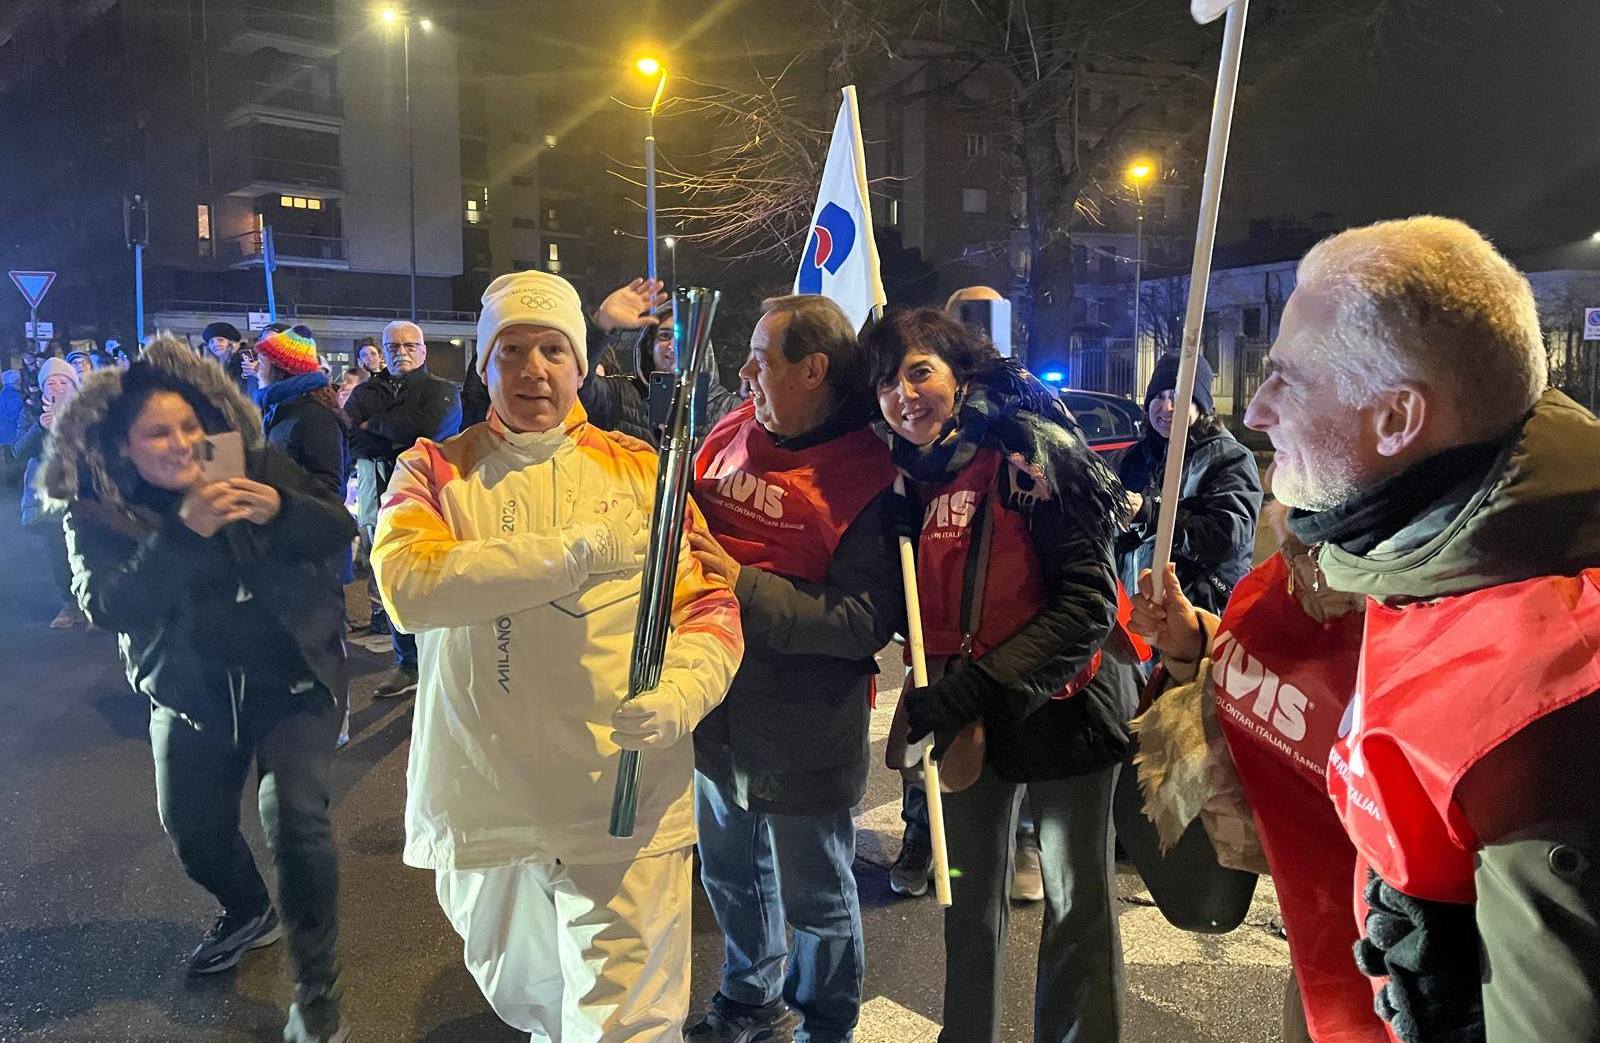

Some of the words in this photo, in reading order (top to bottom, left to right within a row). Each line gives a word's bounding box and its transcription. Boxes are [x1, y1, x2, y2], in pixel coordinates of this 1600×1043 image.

[502, 500, 516, 532] 2026
[497, 617, 512, 694] MILANO
[1255, 726, 1292, 755] ITALIANI
